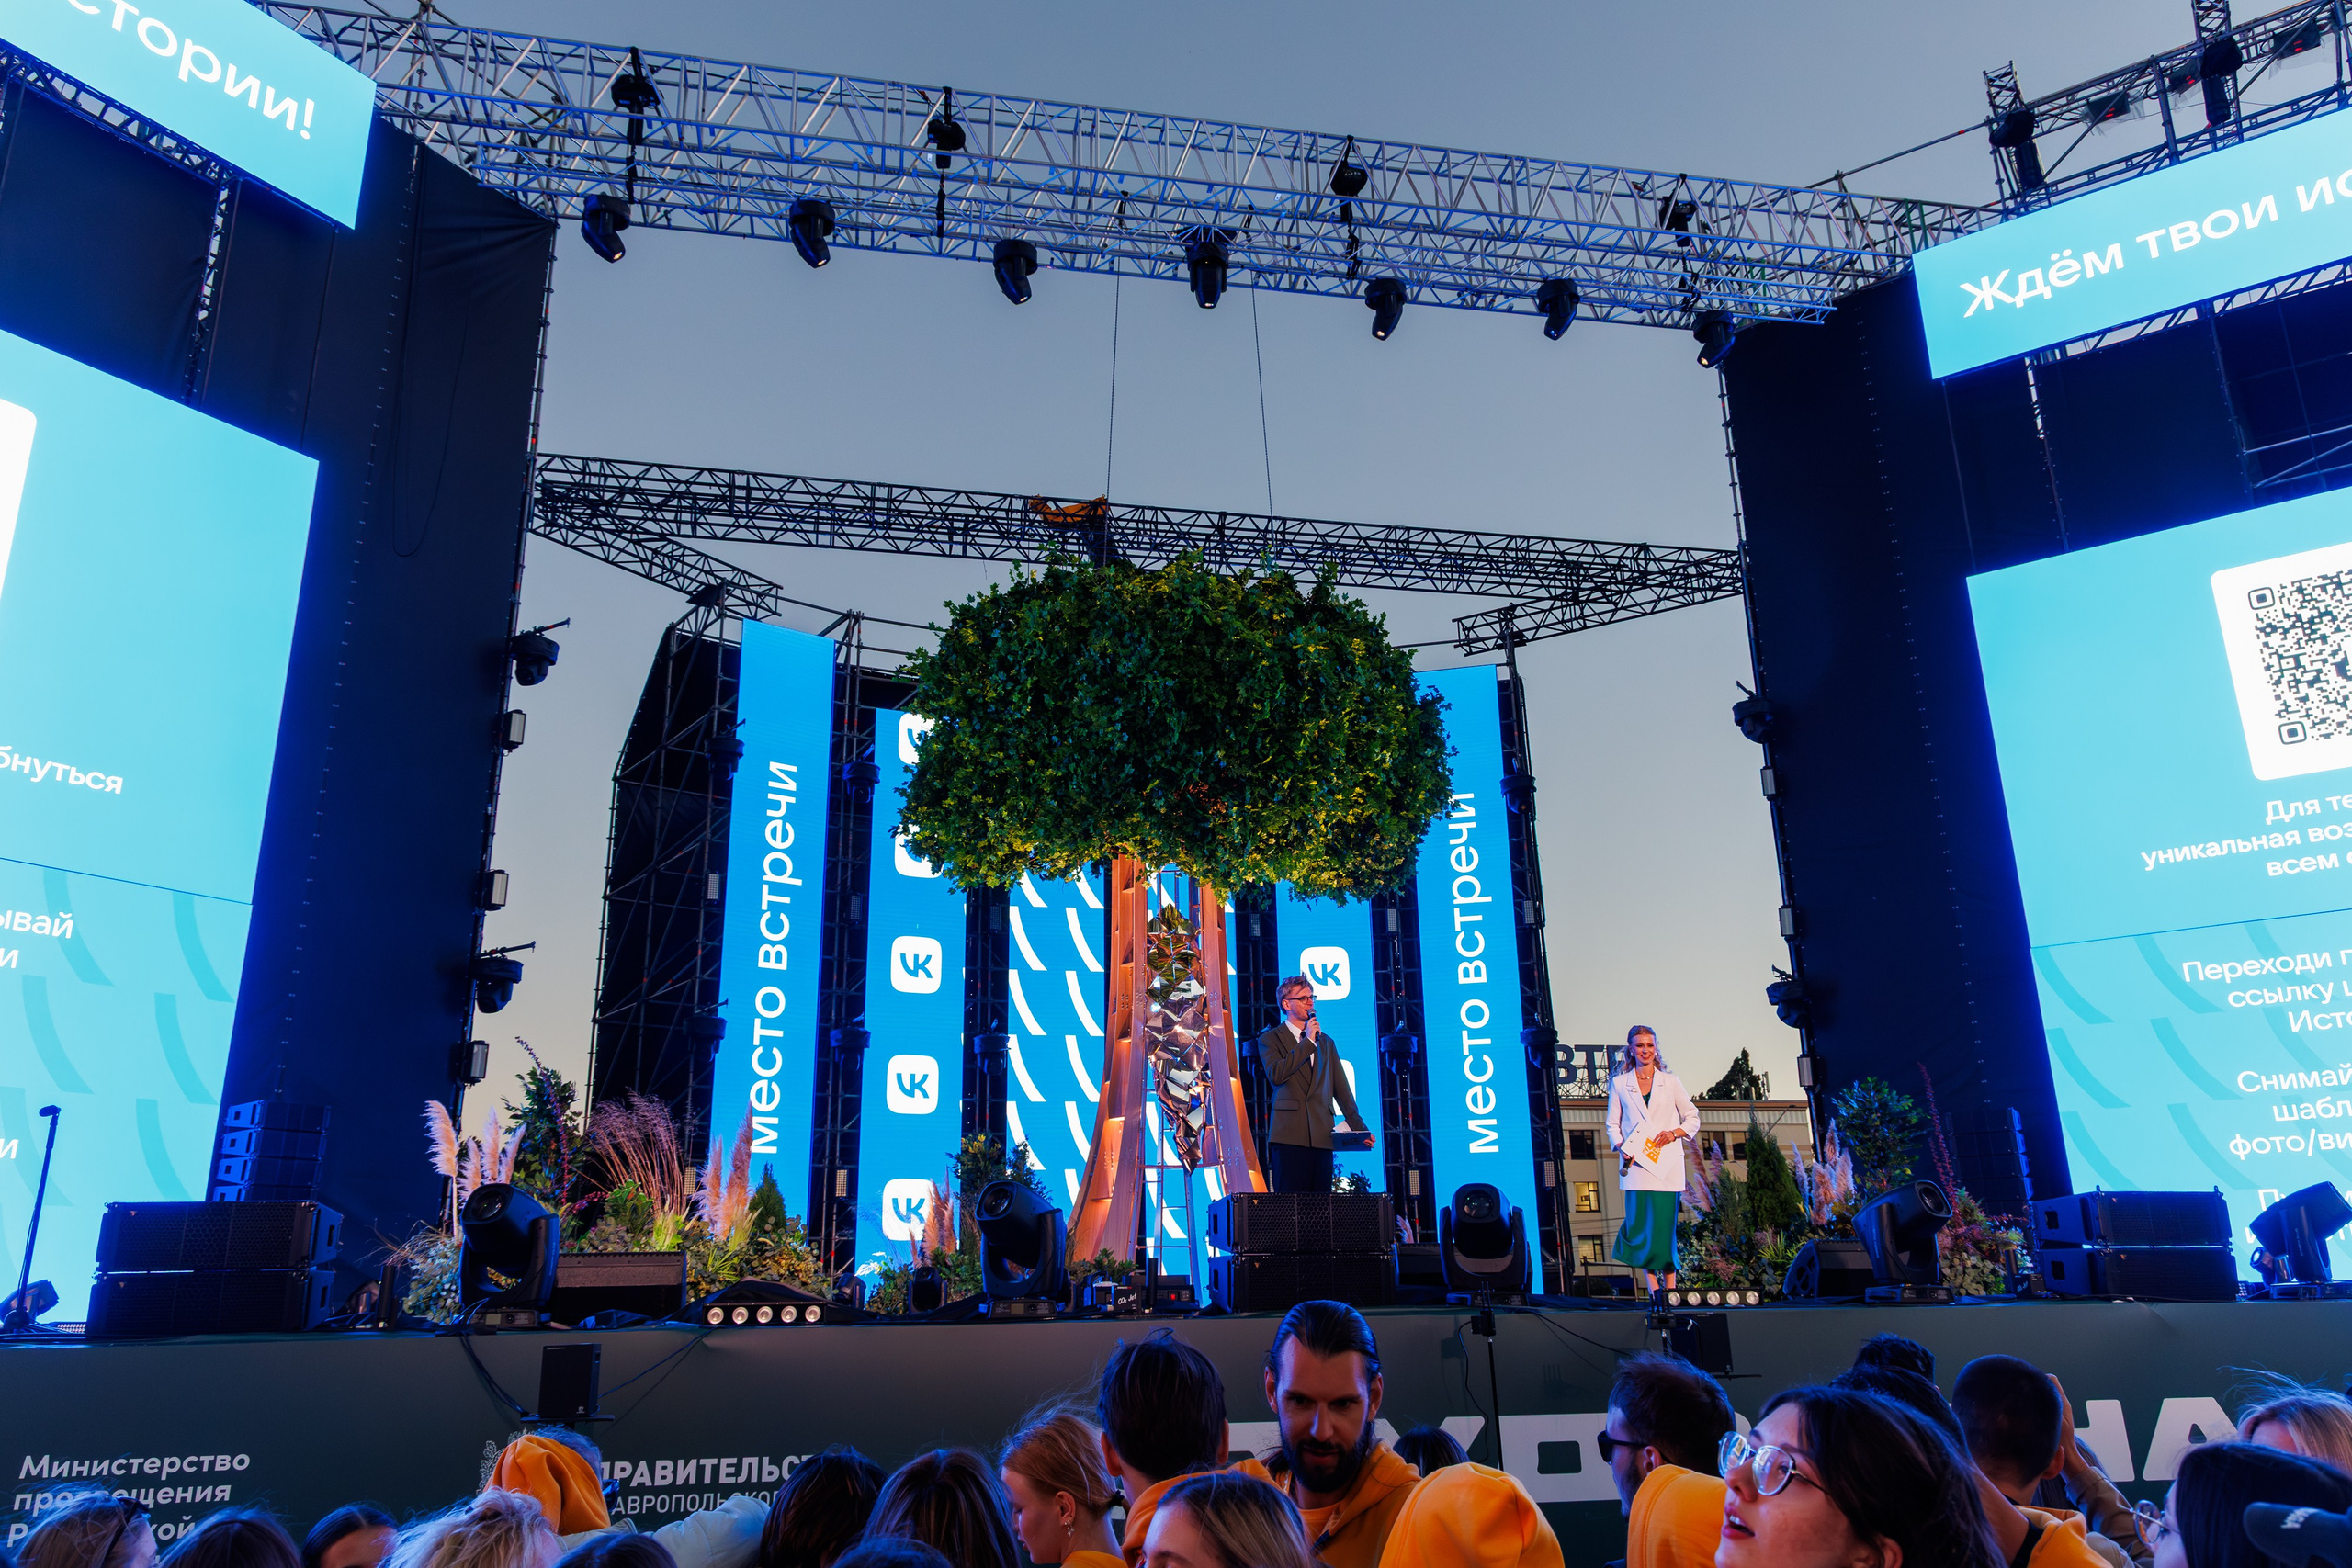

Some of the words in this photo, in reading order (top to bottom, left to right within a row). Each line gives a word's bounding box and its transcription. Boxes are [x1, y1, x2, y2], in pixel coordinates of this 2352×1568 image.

[1959, 243, 2125, 318] Ждём
[2135, 194, 2278, 260] твои
[0, 745, 123, 795] бнуться
[2265, 799, 2322, 826] Для
[2141, 829, 2301, 872] уникальная
[2307, 821, 2352, 843] воз
[757, 761, 803, 971] встречи
[2266, 852, 2340, 877] всем
[1448, 793, 1493, 985] встречи
[2182, 951, 2333, 984] Переходи
[2227, 981, 2334, 1008] ссылку
[749, 986, 786, 1154] место
[1460, 998, 1499, 1154] место
[2237, 1062, 2352, 1093] Снимай
[2272, 1095, 2352, 1122] шабл
[2229, 1128, 2352, 1160] фото/ви
[18, 1453, 251, 1481] Министерство
[601, 1455, 814, 1487] РАВИТЕЛЬС
[13, 1484, 232, 1517] прощения
